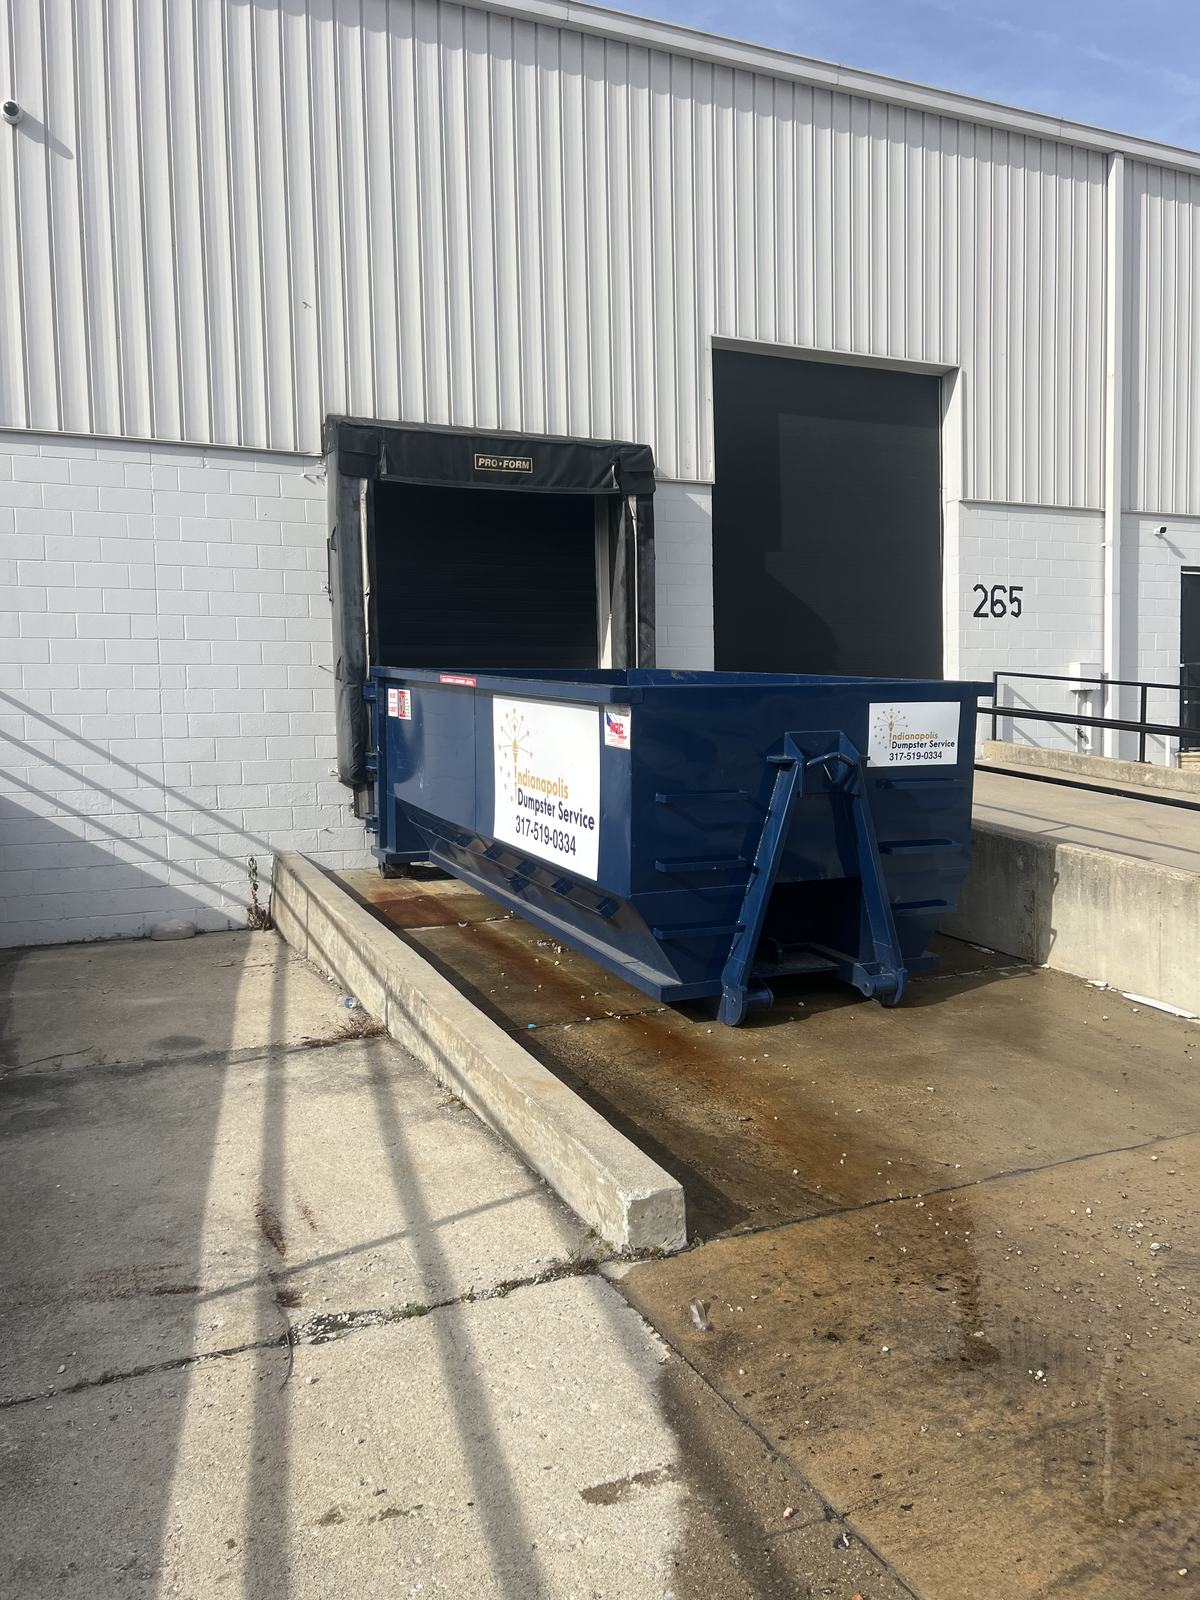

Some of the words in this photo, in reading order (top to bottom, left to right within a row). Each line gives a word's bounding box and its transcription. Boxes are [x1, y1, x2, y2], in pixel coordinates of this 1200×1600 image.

[973, 584, 1023, 618] 265
[889, 731, 938, 741] Indianapolis
[891, 740, 927, 750] Dumpster
[929, 739, 955, 748] Service
[889, 751, 942, 761] 317-519-0334
[517, 787, 556, 817] Dumpster
[558, 800, 595, 830] Service
[515, 814, 577, 856] 317-519-0334
